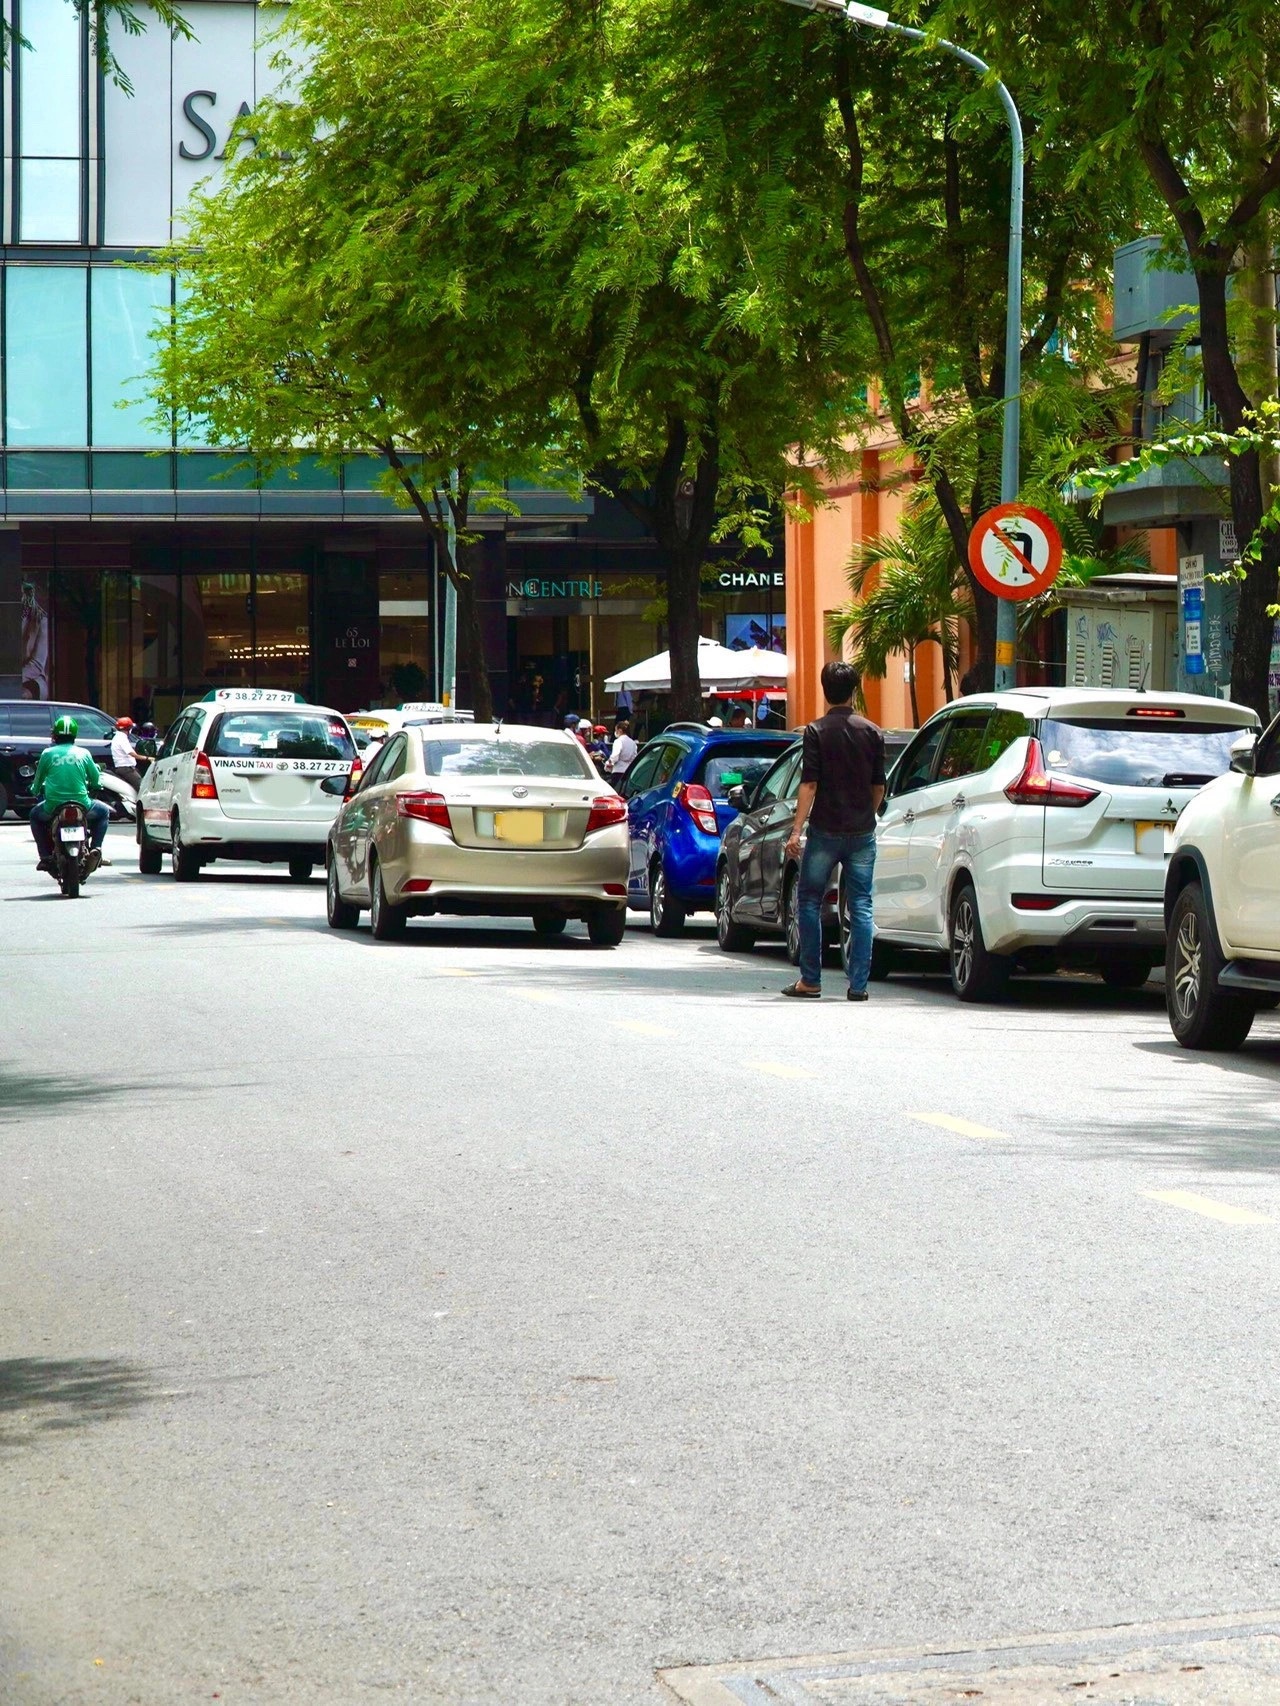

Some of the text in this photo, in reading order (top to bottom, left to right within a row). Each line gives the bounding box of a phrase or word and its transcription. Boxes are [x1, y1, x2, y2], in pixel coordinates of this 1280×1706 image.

[719, 573, 784, 586] CHANE
[524, 578, 603, 597] CENTRE
[266, 693, 277, 701] 27
[281, 694, 292, 702] 27
[214, 760, 350, 772] VINASUN TAXI 38.27 27 27
